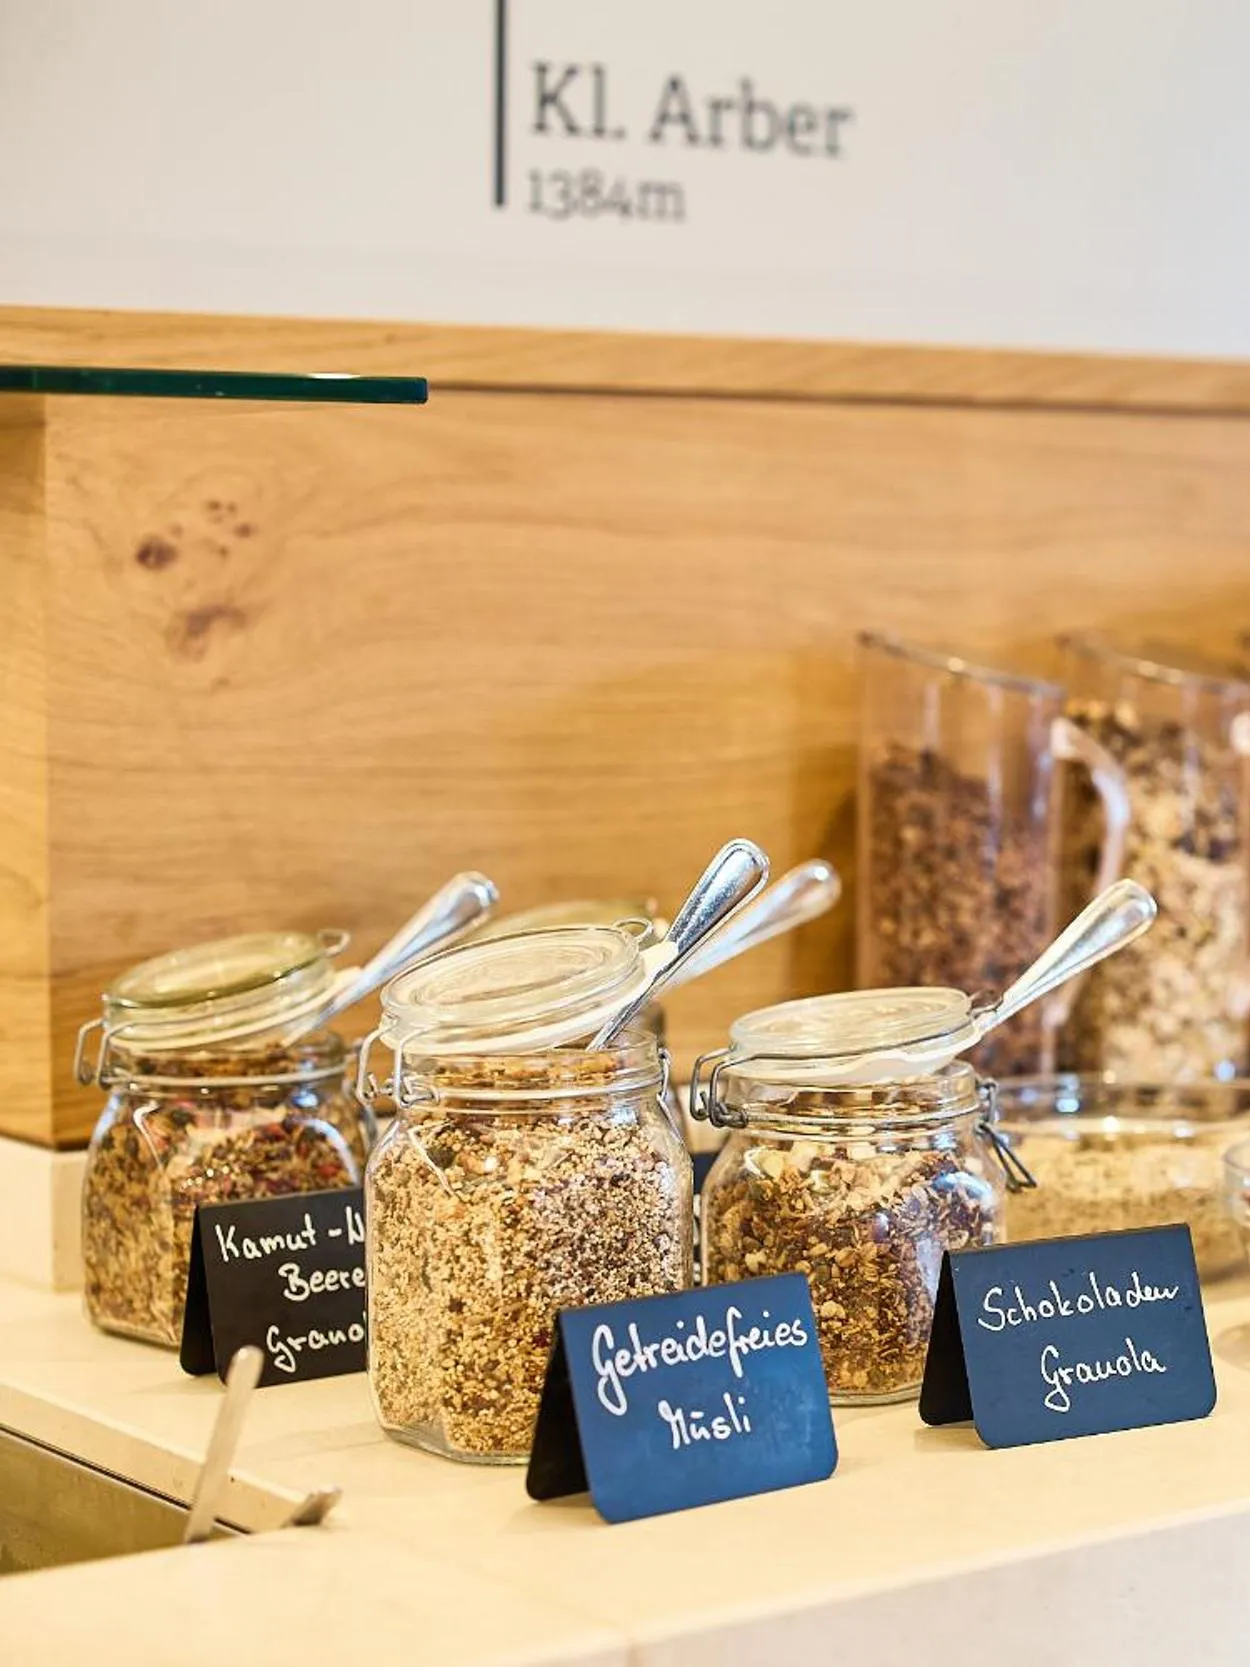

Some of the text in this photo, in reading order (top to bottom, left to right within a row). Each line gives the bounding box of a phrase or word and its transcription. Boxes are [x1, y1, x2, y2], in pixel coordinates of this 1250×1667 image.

[529, 60, 854, 158] Kl. Arber
[526, 168, 687, 225] 1384m
[977, 1271, 1179, 1331] Schokoladen
[266, 1310, 367, 1373] Grano
[592, 1306, 808, 1416] Getreidefreies
[1040, 1337, 1167, 1413] Granola
[658, 1392, 751, 1449] Müsli
